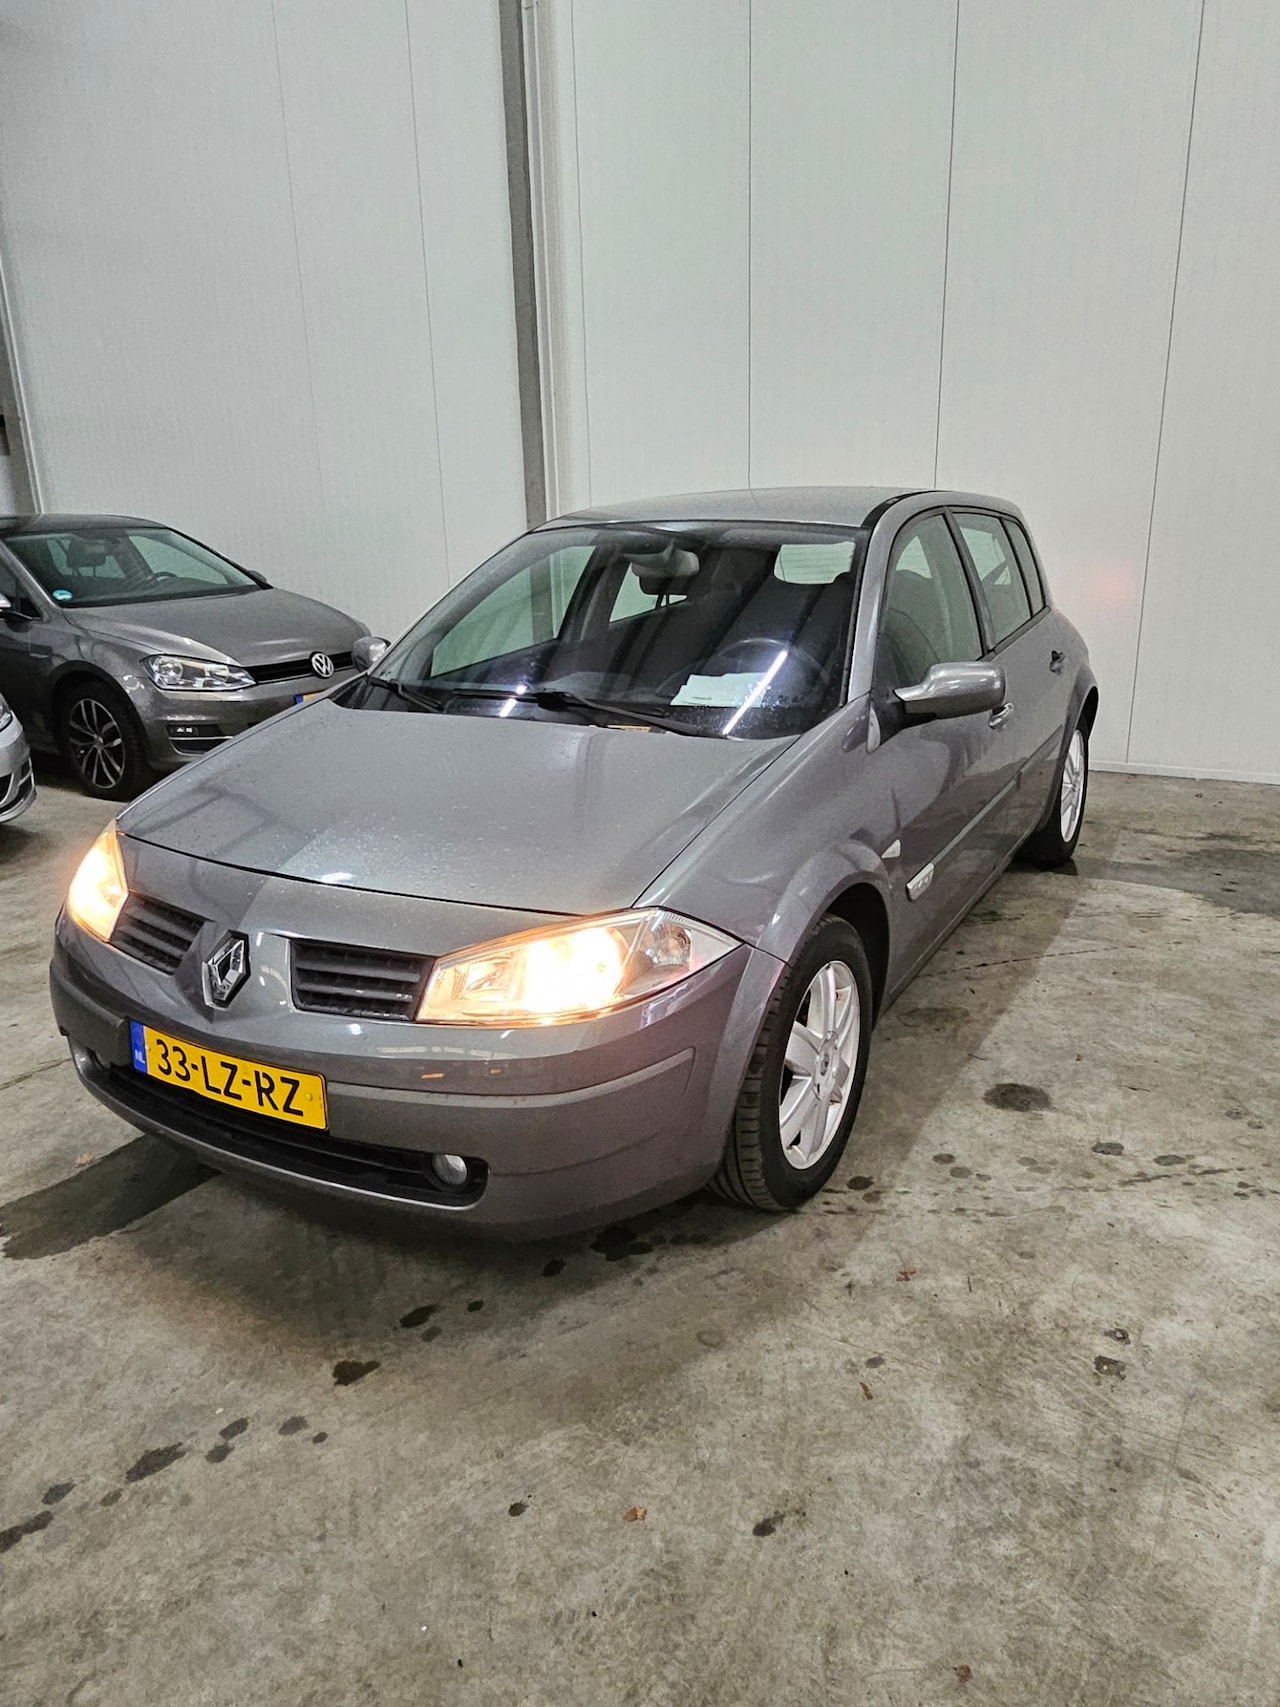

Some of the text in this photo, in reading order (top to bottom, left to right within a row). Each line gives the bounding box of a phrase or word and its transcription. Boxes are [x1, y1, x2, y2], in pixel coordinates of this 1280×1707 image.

[312, 653, 334, 678] VW
[134, 1049, 146, 1064] NL
[156, 1039, 304, 1117] 33-LZ-RZ
